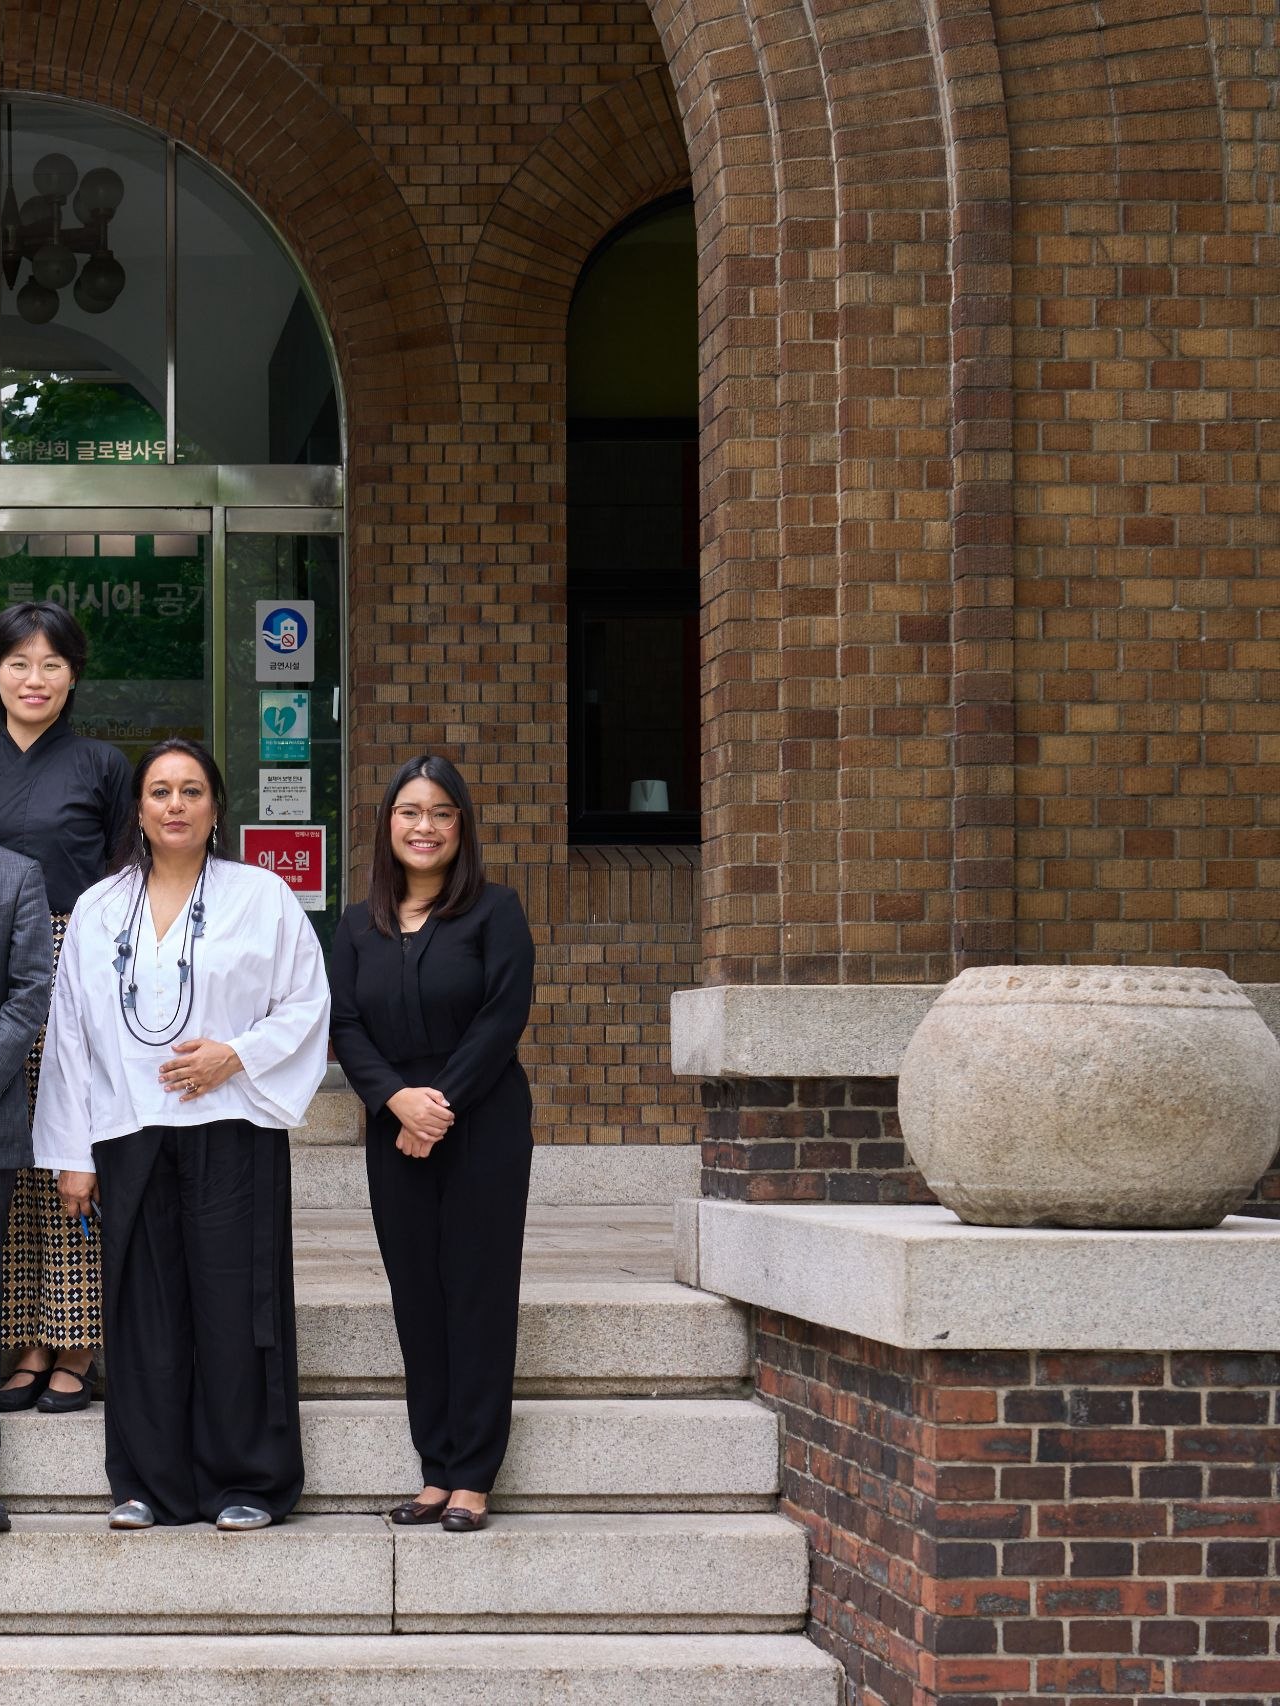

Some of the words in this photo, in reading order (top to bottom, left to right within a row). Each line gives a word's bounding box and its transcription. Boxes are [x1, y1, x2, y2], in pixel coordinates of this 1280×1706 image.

[46, 580, 146, 617] 아시아
[269, 661, 300, 670] 금연시설
[72, 725, 97, 737] st's
[107, 724, 152, 737] House
[258, 850, 310, 871] 에스원
